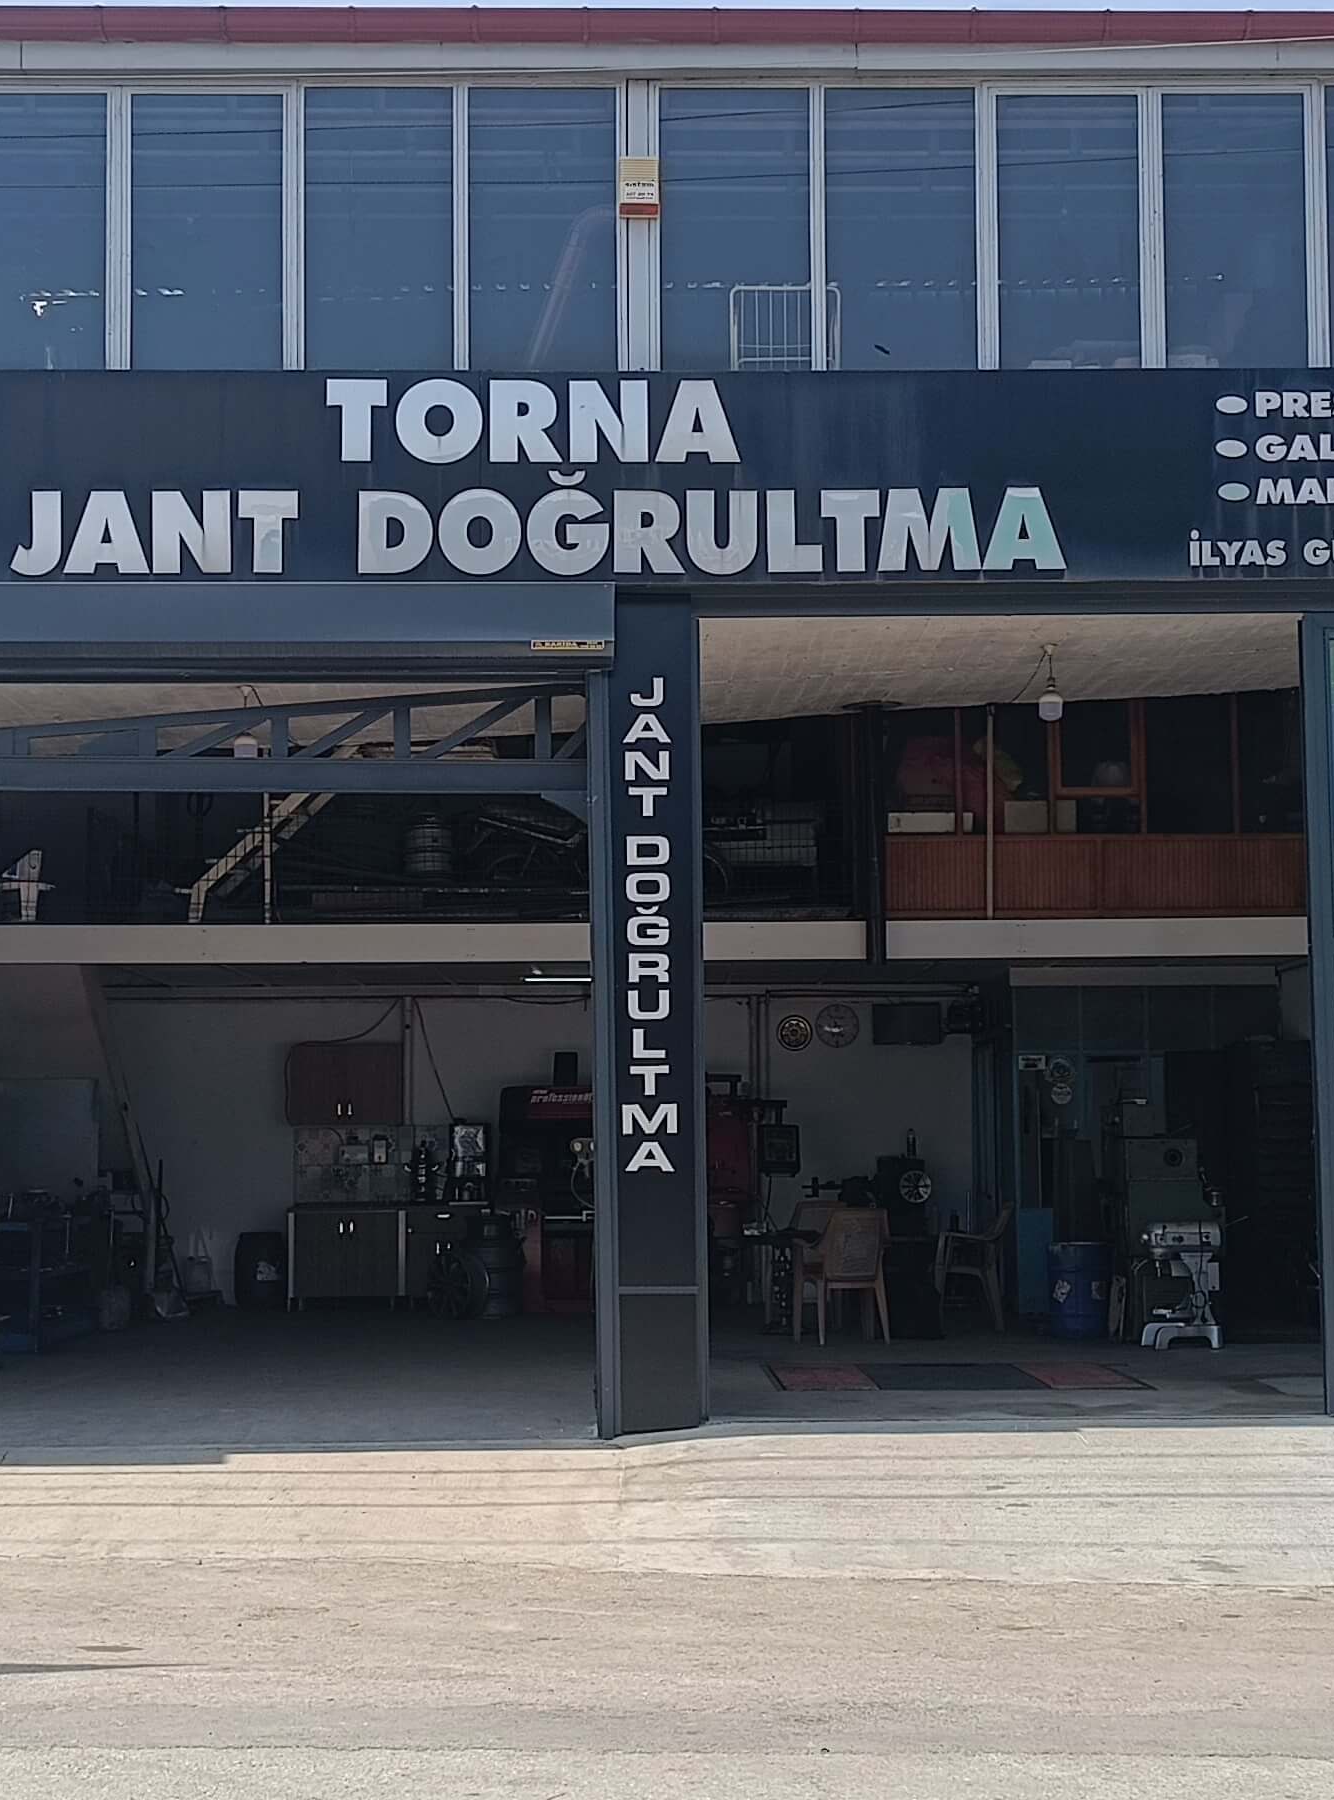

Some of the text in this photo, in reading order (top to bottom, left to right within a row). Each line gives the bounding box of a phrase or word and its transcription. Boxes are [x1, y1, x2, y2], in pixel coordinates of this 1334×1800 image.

[325, 377, 741, 464] TORNA
[8, 469, 1067, 576] JANT DOĞRULTMA
[1188, 529, 1287, 568] İLYAS
[621, 677, 678, 1172] JANT DOĞRULTMA
